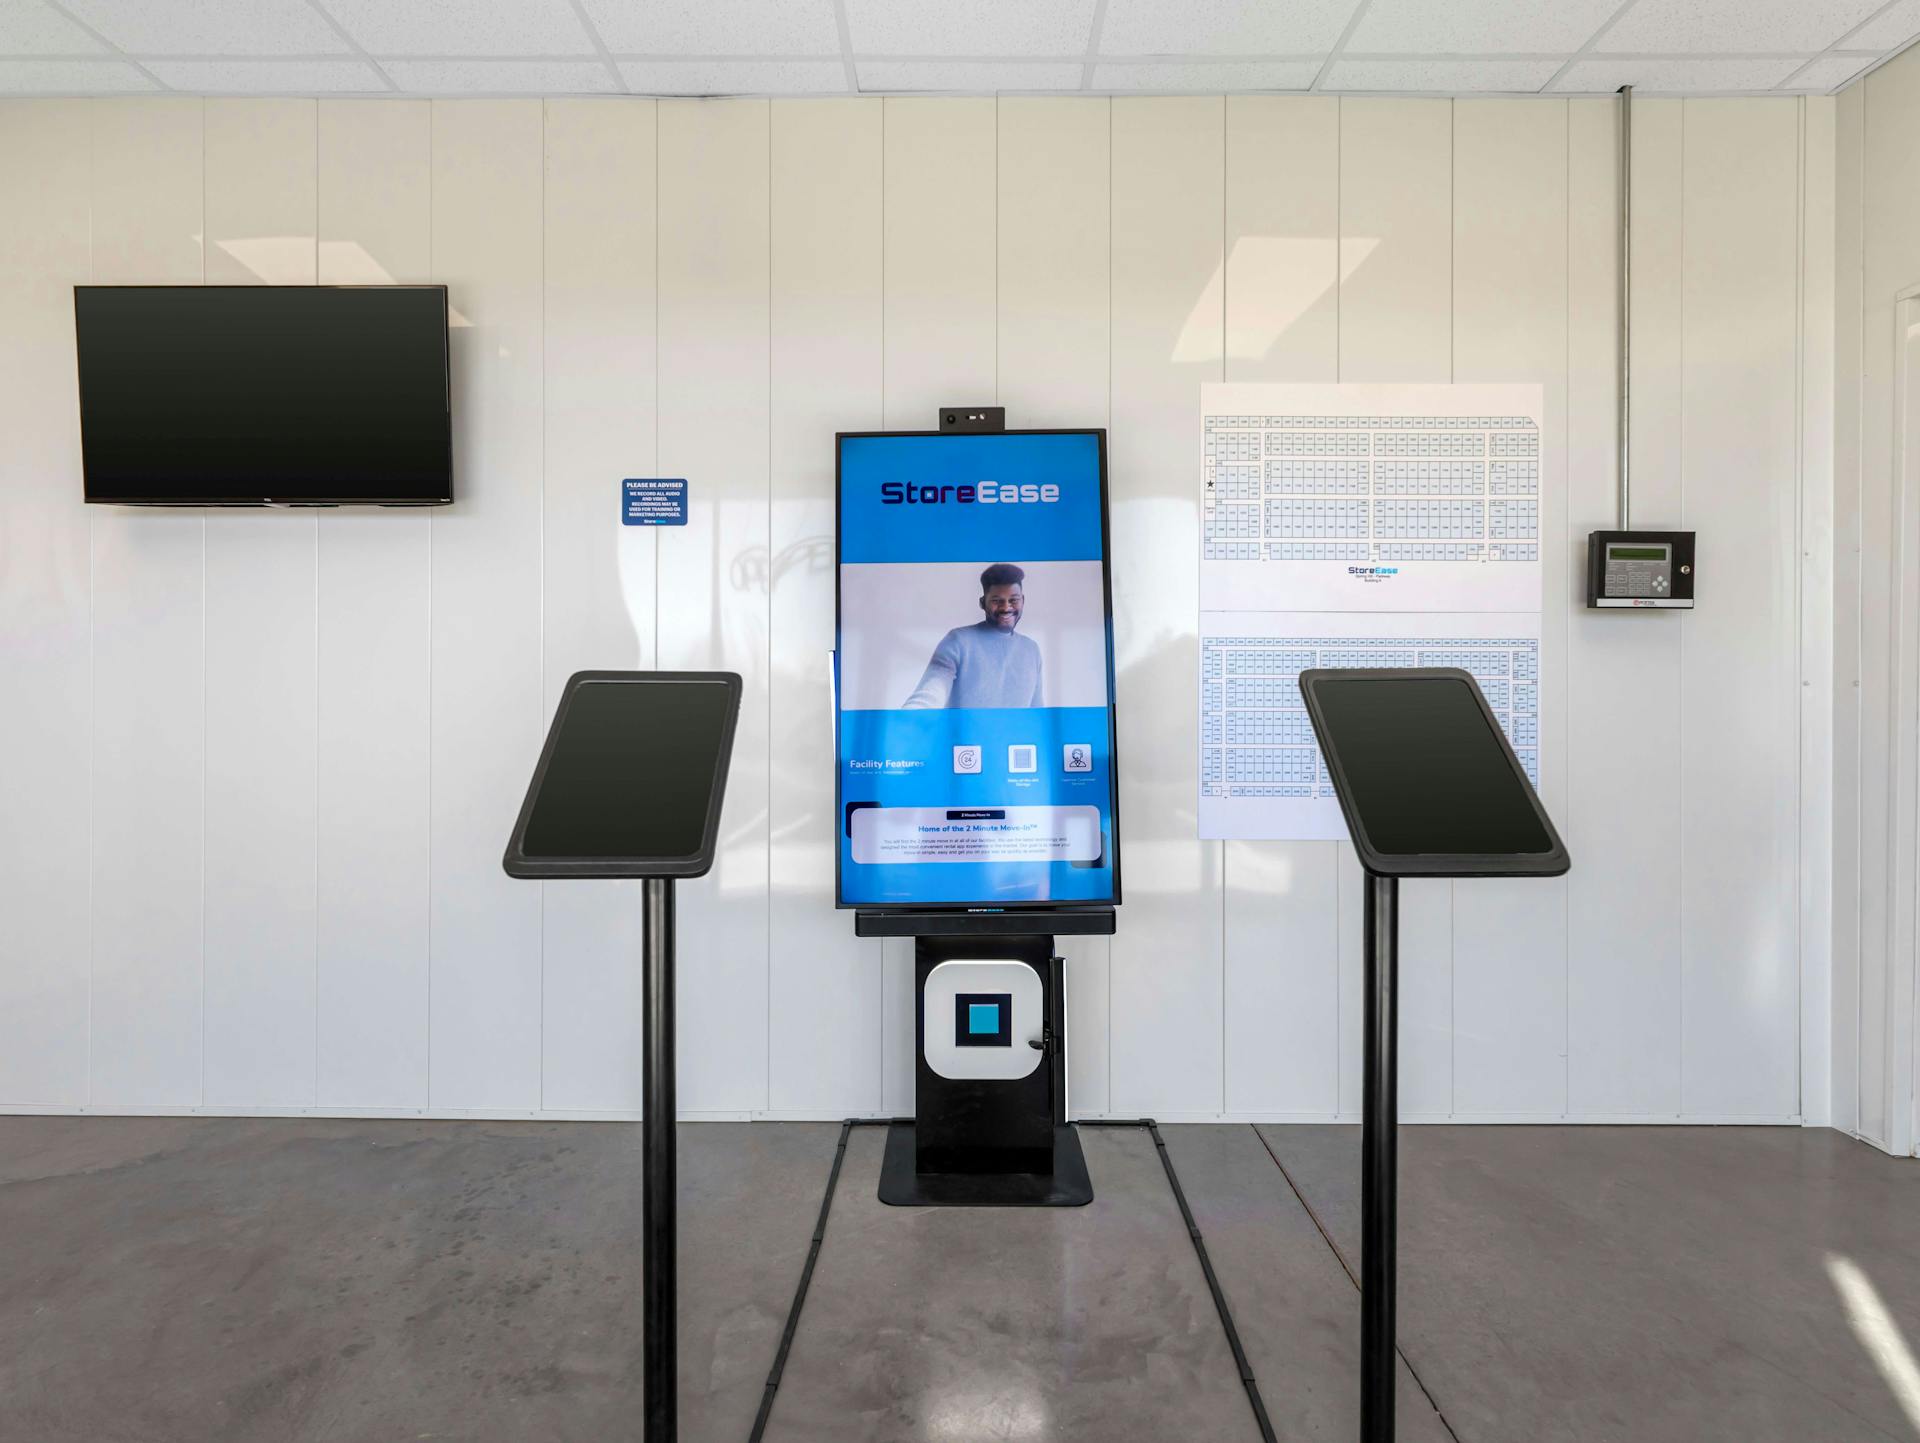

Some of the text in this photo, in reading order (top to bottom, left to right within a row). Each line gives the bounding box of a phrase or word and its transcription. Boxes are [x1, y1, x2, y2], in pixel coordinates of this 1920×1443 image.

[881, 480, 1060, 504] StoreEase
[1348, 566, 1398, 574] StoreEase
[850, 759, 925, 769] Facility Features
[918, 825, 940, 833] Home
